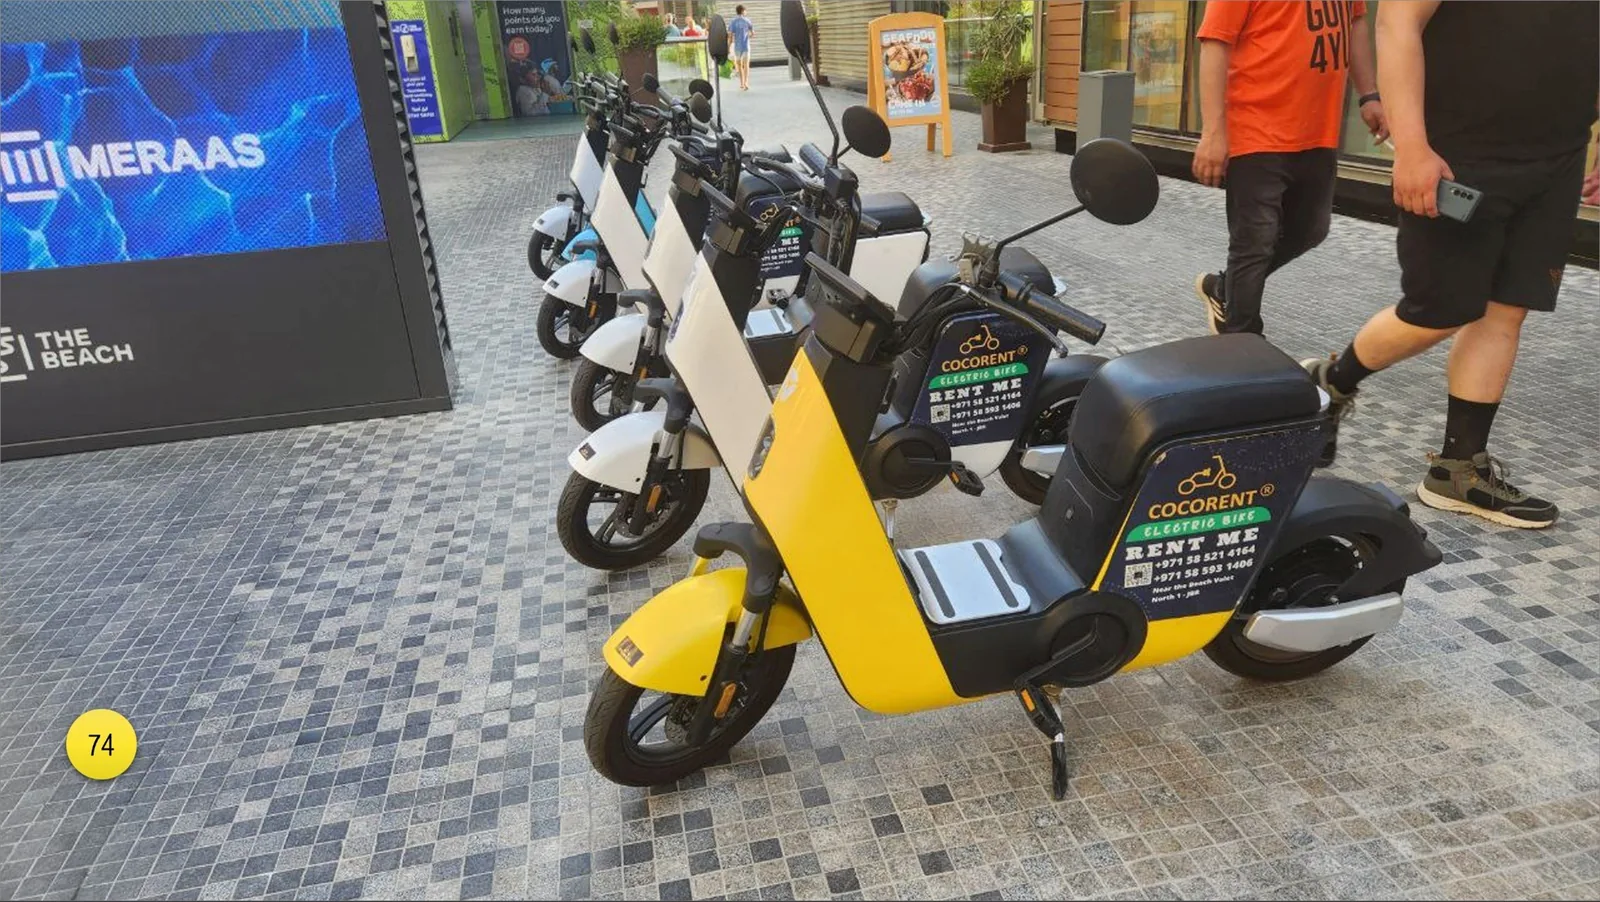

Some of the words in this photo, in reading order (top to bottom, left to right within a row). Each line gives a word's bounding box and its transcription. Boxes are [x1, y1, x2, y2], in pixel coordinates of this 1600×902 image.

[504, 17, 530, 26] points
[544, 16, 561, 24] you
[522, 6, 545, 15] many
[525, 24, 553, 34] today?
[68, 133, 265, 181] MERAAS
[34, 327, 92, 350] THE
[40, 343, 134, 369] BEACH
[940, 370, 990, 385] ELECTRIC
[994, 365, 1017, 377] BIKE
[929, 385, 984, 403] RENT
[992, 378, 1022, 392] ME
[951, 400, 970, 409] +971
[973, 398, 982, 407] 58
[985, 395, 999, 404] 521
[1001, 391, 1022, 400] 4164
[951, 410, 970, 419] +971
[973, 408, 983, 417] 58
[985, 405, 999, 414] 593
[1002, 401, 1021, 411] 1406
[1144, 517, 1216, 537] ELECTRIC
[1222, 510, 1255, 525] BIKE
[1125, 536, 1205, 560] RENT
[1216, 527, 1259, 547] ME
[1154, 557, 1183, 569] +971
[1186, 555, 1201, 565] 58
[1203, 549, 1224, 562] 521
[1227, 544, 1255, 557] 4164
[1153, 571, 1182, 583] +971
[1184, 568, 1200, 578] 58
[1201, 564, 1223, 575] 593
[1226, 558, 1253, 570] 1406
[1152, 586, 1172, 594] Near
[1188, 578, 1212, 588] Beach
[1213, 575, 1235, 583] Valet
[1151, 594, 1175, 603] North
